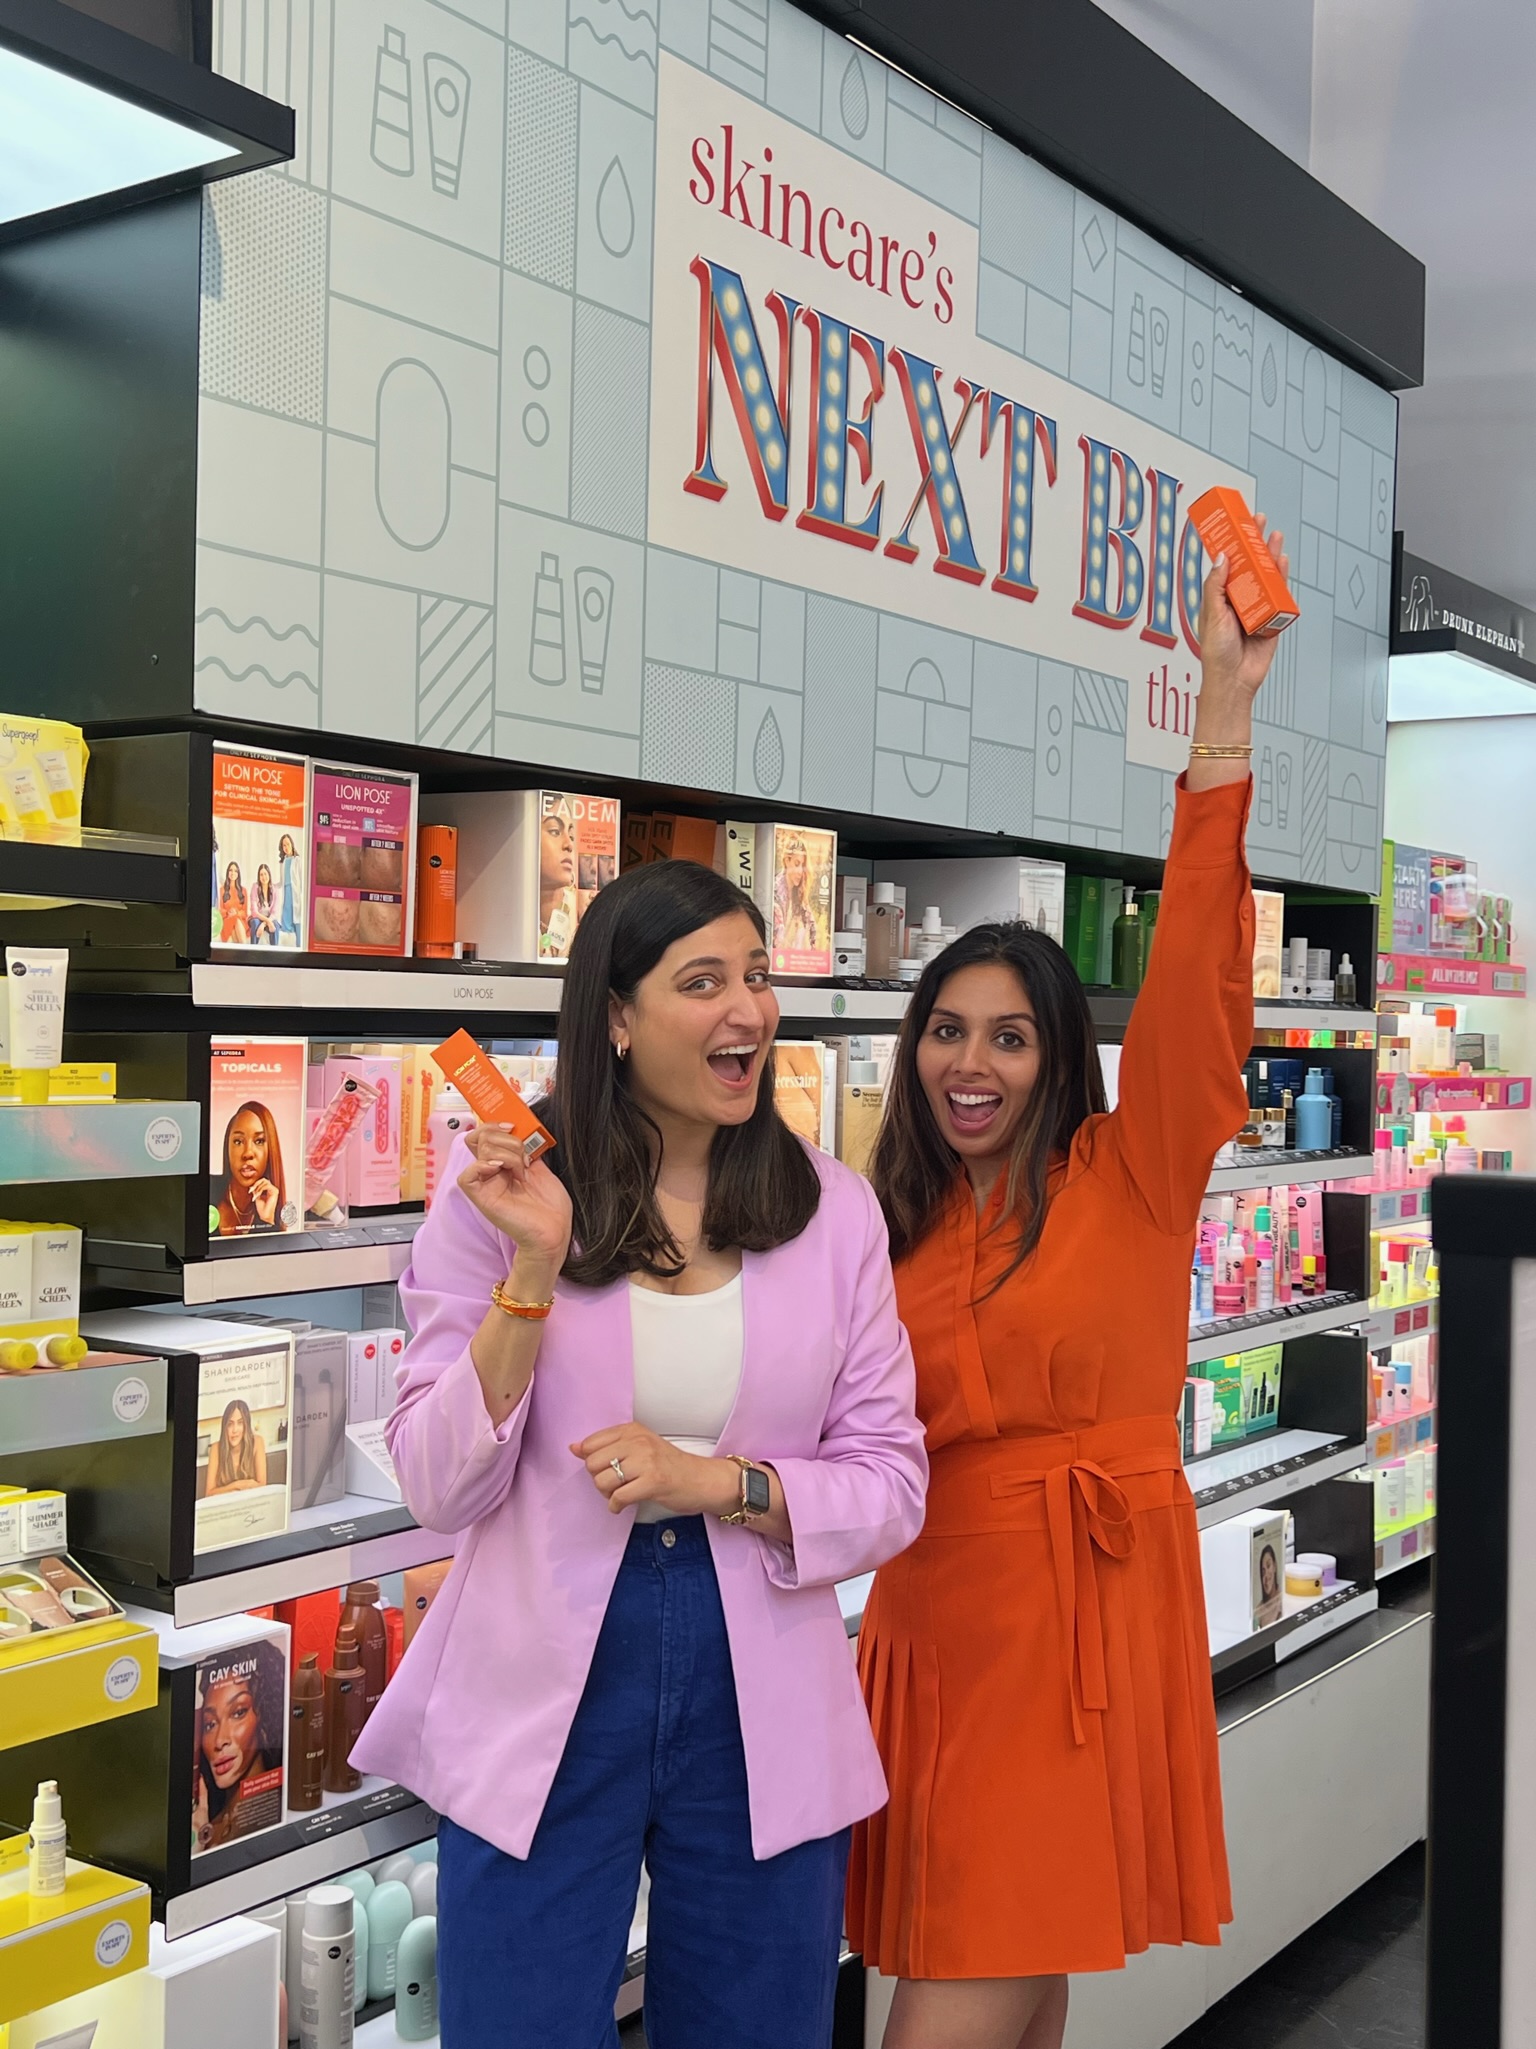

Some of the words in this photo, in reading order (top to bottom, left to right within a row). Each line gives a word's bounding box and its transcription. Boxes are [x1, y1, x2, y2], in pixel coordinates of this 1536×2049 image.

[689, 125, 953, 324] skincare's
[683, 253, 1057, 602] NEXT
[1442, 610, 1474, 636] DRUNK
[1475, 623, 1524, 655] ELEPHANT
[1146, 664, 1200, 737] thi
[2, 723, 40, 745] Supergoop!
[222, 763, 250, 781] LION
[253, 767, 282, 785] POSE
[335, 784, 361, 801] LION
[364, 788, 390, 805] POSE
[341, 803, 374, 814] UNSPOTTED
[542, 796, 616, 824] EADEM
[26, 994, 59, 1004] SHEER
[453, 988, 473, 998] LION
[474, 988, 494, 999] POSE
[23, 1003, 62, 1012] SCREEN
[221, 1063, 282, 1073] TOPICALS
[775, 1072, 817, 1088] écessaire
[0, 1292, 18, 1300] LOW
[43, 1286, 68, 1295] GLOW
[0, 1299, 22, 1308] REEN
[39, 1294, 71, 1303] SCREEN
[204, 1367, 232, 1379] SHANI
[235, 1361, 271, 1374] DARDEN
[296, 1412, 328, 1423] DARDEN
[27, 1510, 63, 1523] SHIMMER
[32, 1519, 58, 1529] SHADE
[209, 1666, 230, 1684] CAY
[231, 1658, 257, 1677] SKIN
